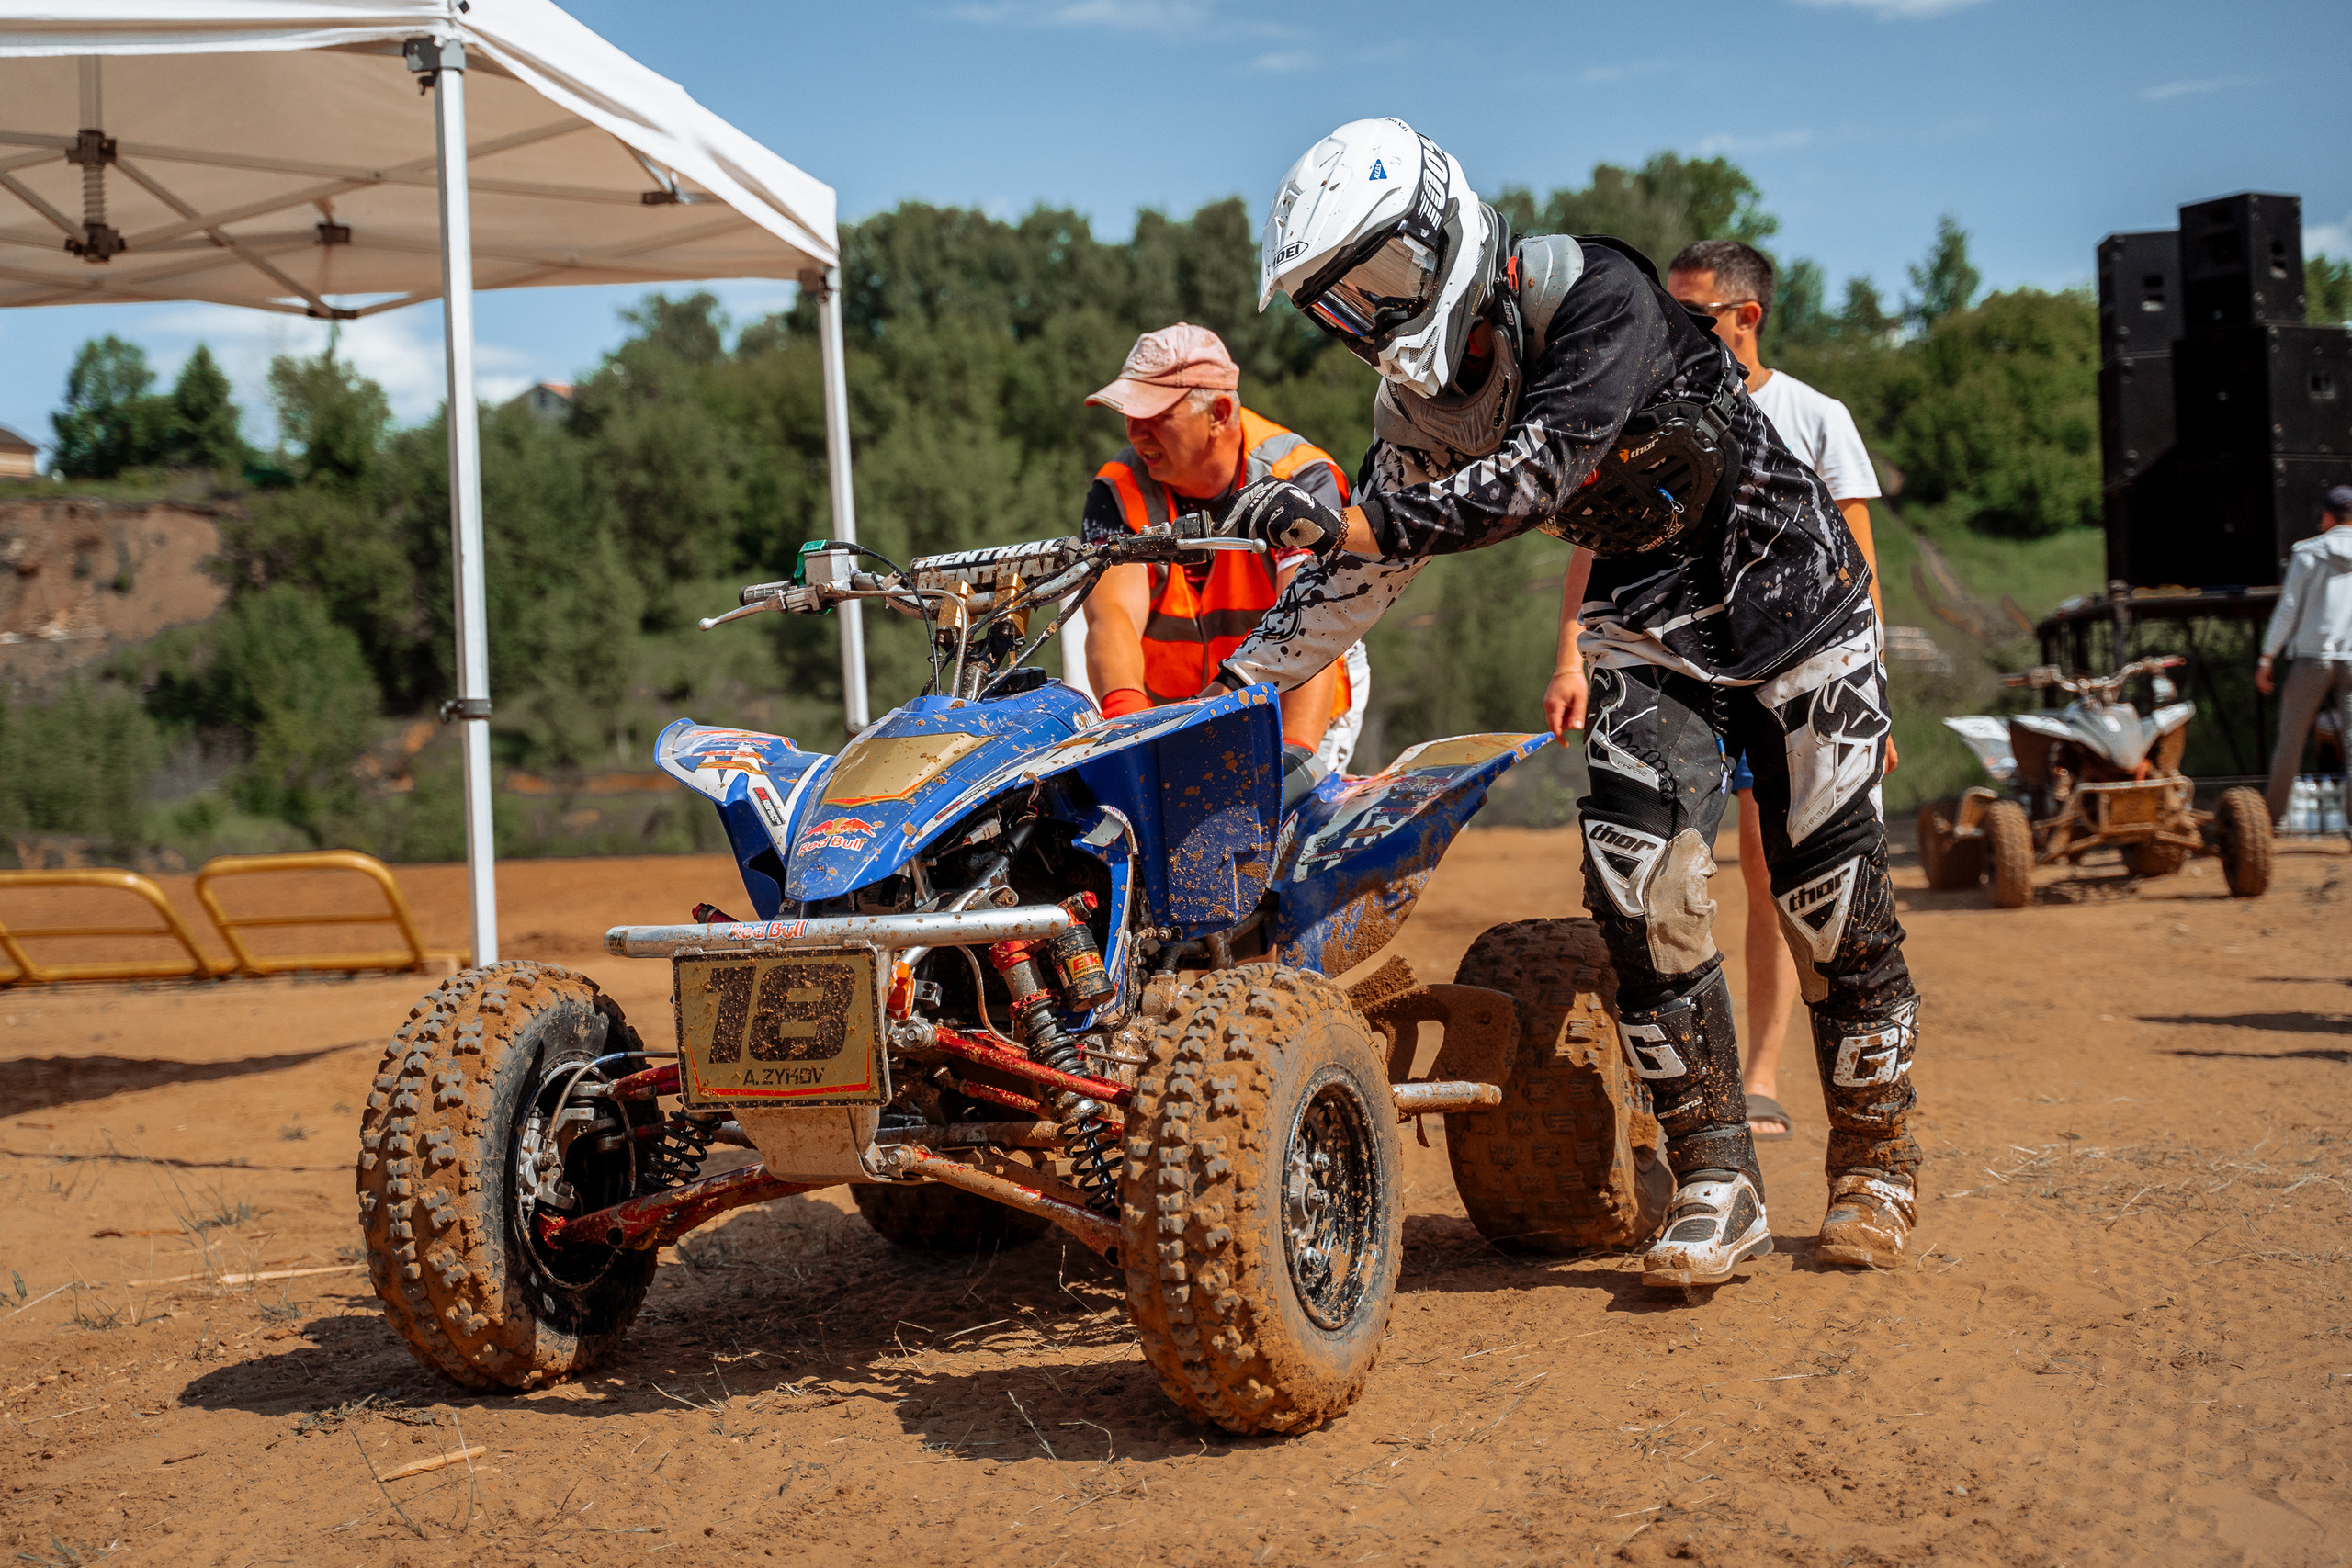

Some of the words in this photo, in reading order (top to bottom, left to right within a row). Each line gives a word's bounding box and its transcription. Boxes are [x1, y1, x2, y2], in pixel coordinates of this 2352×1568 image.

[1630, 438, 1659, 459] thor
[914, 539, 1061, 570] RENTHAL
[797, 836, 830, 856] Red
[829, 835, 865, 852] Bull
[1589, 823, 1658, 852] thor
[1789, 866, 1851, 913] thor
[728, 921, 767, 942] Red
[767, 919, 809, 939] Bull
[707, 963, 856, 1064] 18
